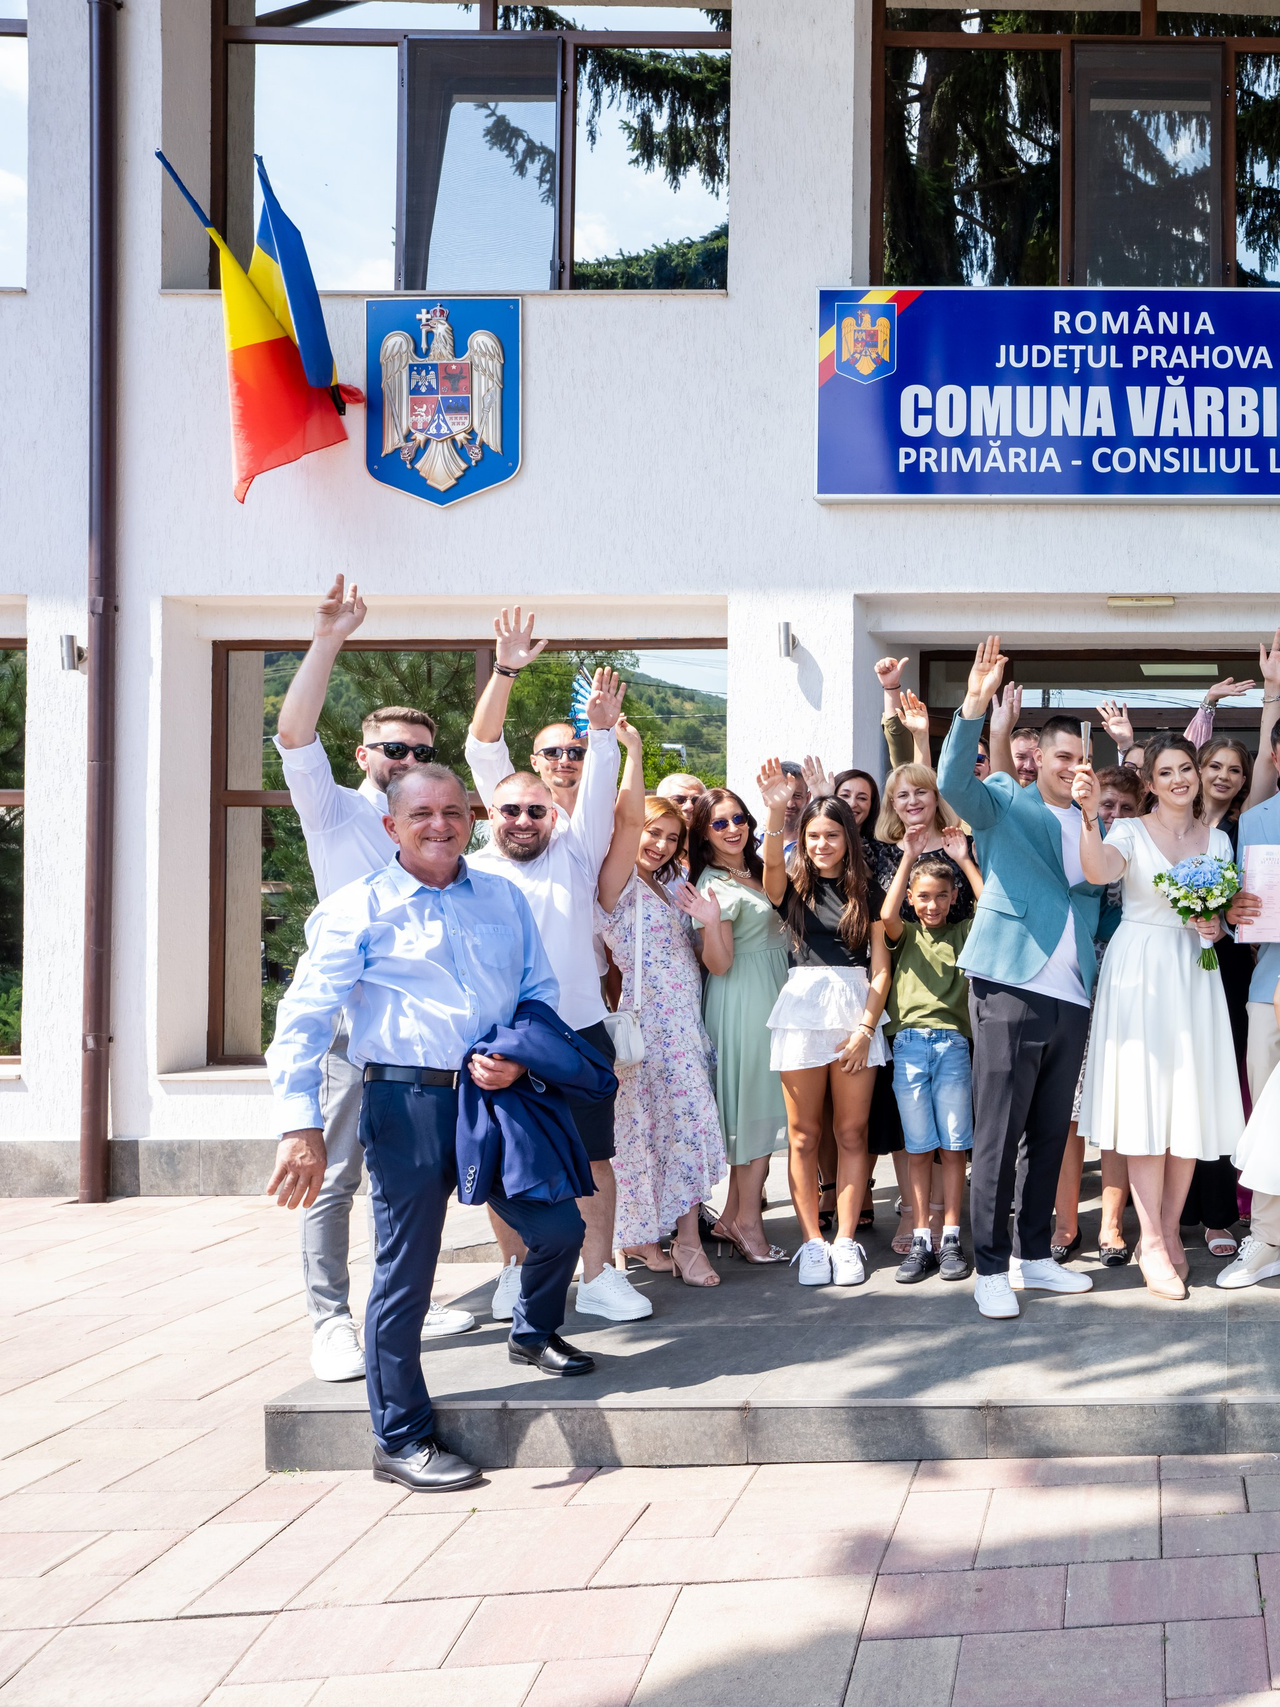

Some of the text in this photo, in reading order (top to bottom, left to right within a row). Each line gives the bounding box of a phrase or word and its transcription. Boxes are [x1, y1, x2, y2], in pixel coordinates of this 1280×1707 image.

[1054, 304, 1215, 335] ROMÂNIA
[995, 344, 1274, 374] JUDEȚUL PRAHOVA
[900, 384, 1117, 438] COMUNA
[898, 438, 1062, 473] PRIMĂRIA
[1092, 447, 1260, 474] CONSILIUL
